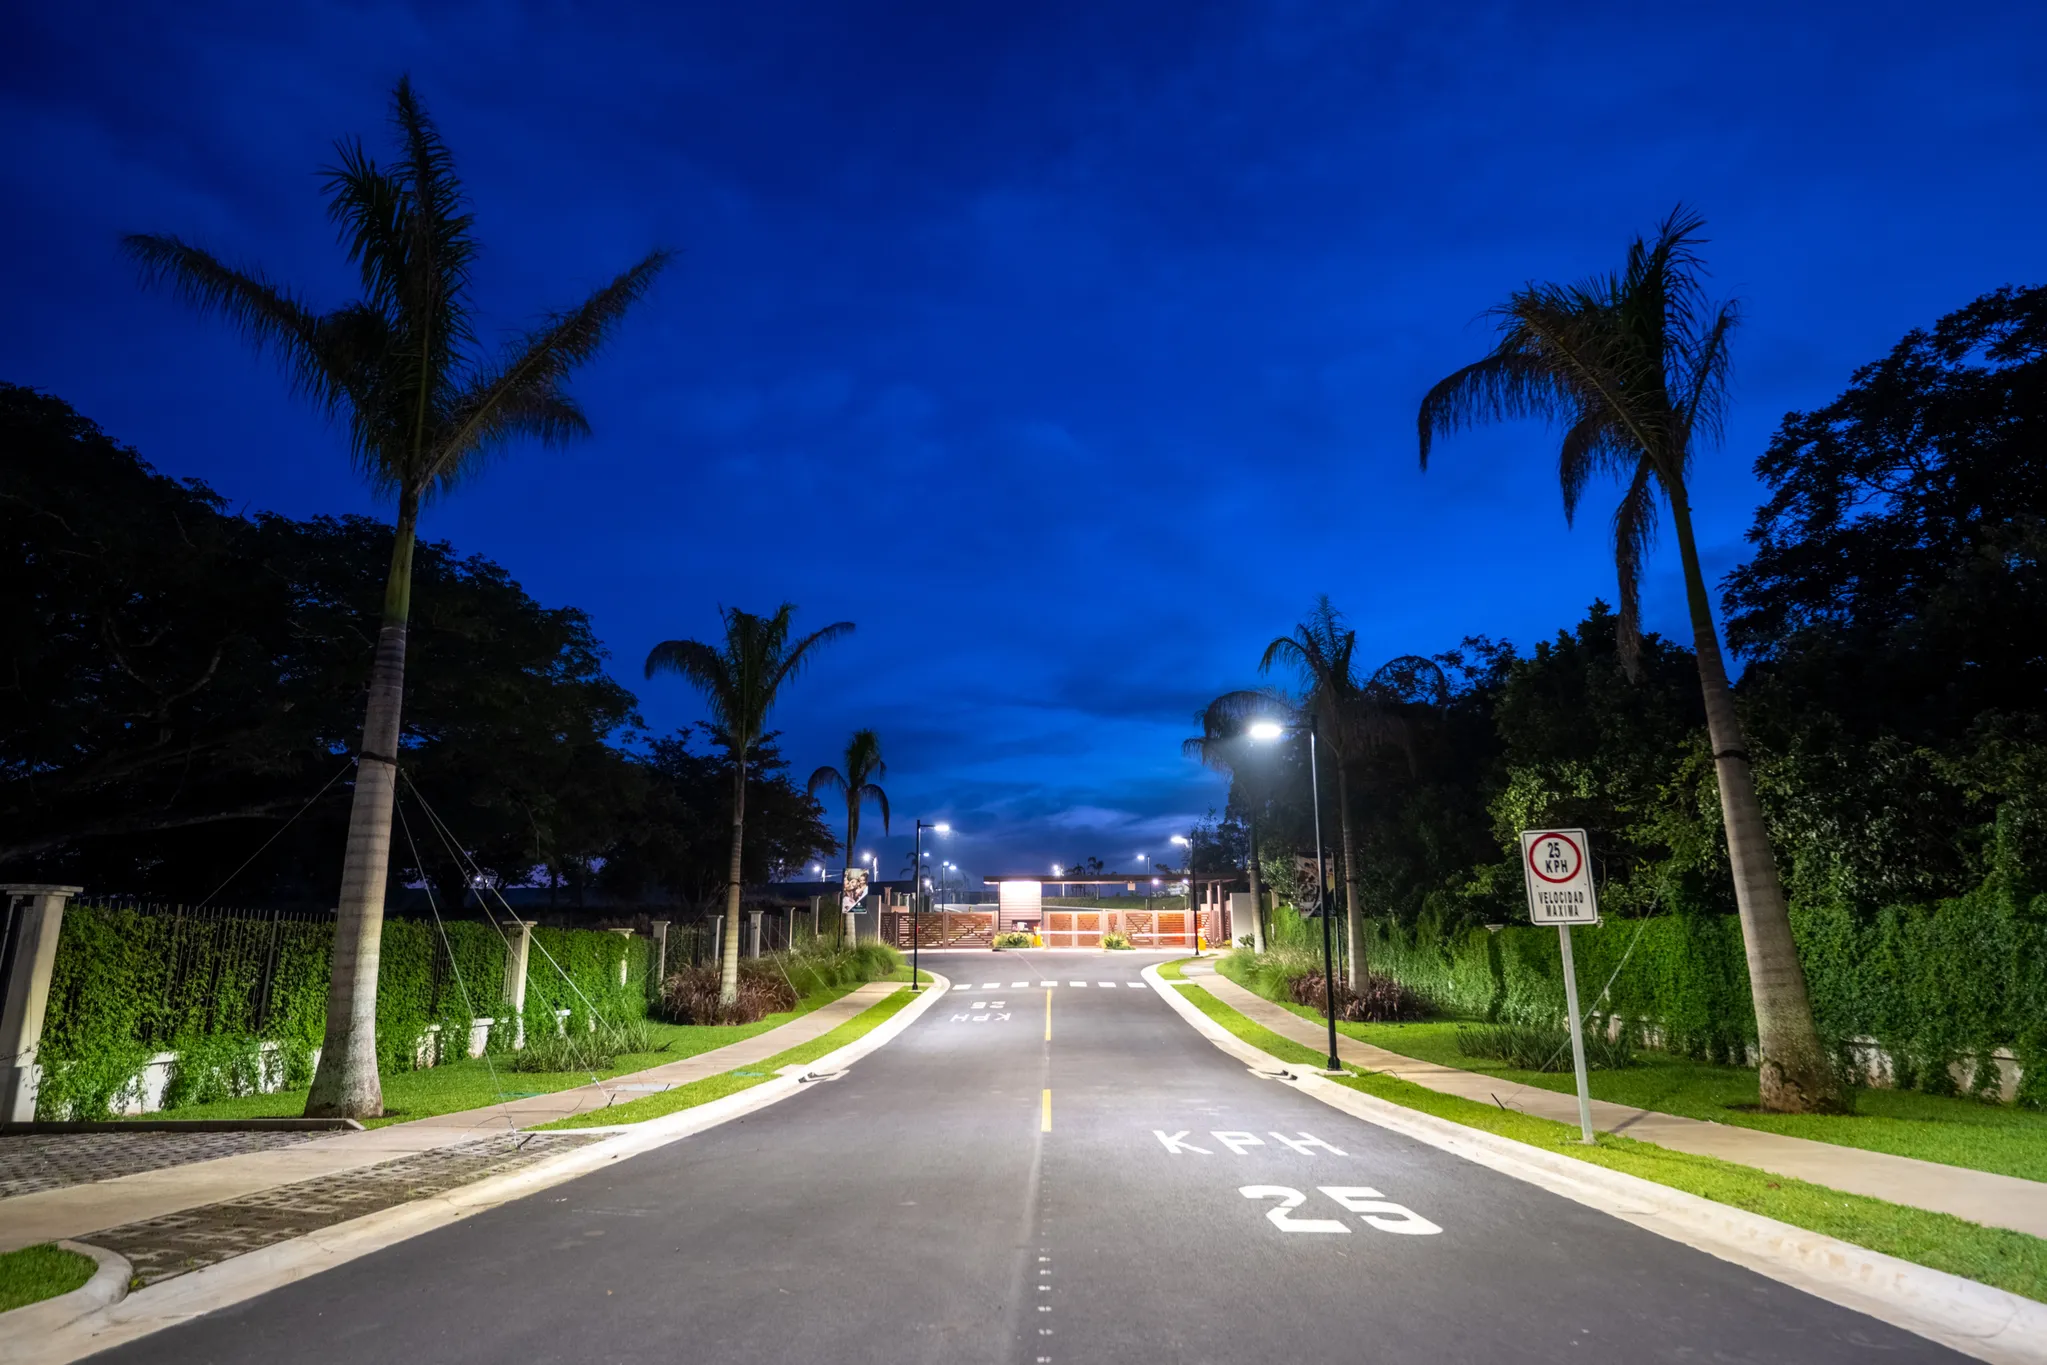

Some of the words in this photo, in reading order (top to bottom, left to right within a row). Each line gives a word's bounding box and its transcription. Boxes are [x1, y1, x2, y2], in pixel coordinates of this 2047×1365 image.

[1547, 842, 1561, 858] 25
[1545, 860, 1569, 873] KPH
[1538, 891, 1584, 904] VELOCIDAD
[1546, 904, 1580, 917] MAXIMA
[1152, 1130, 1349, 1156] KPH
[1238, 1185, 1444, 1235] 25
